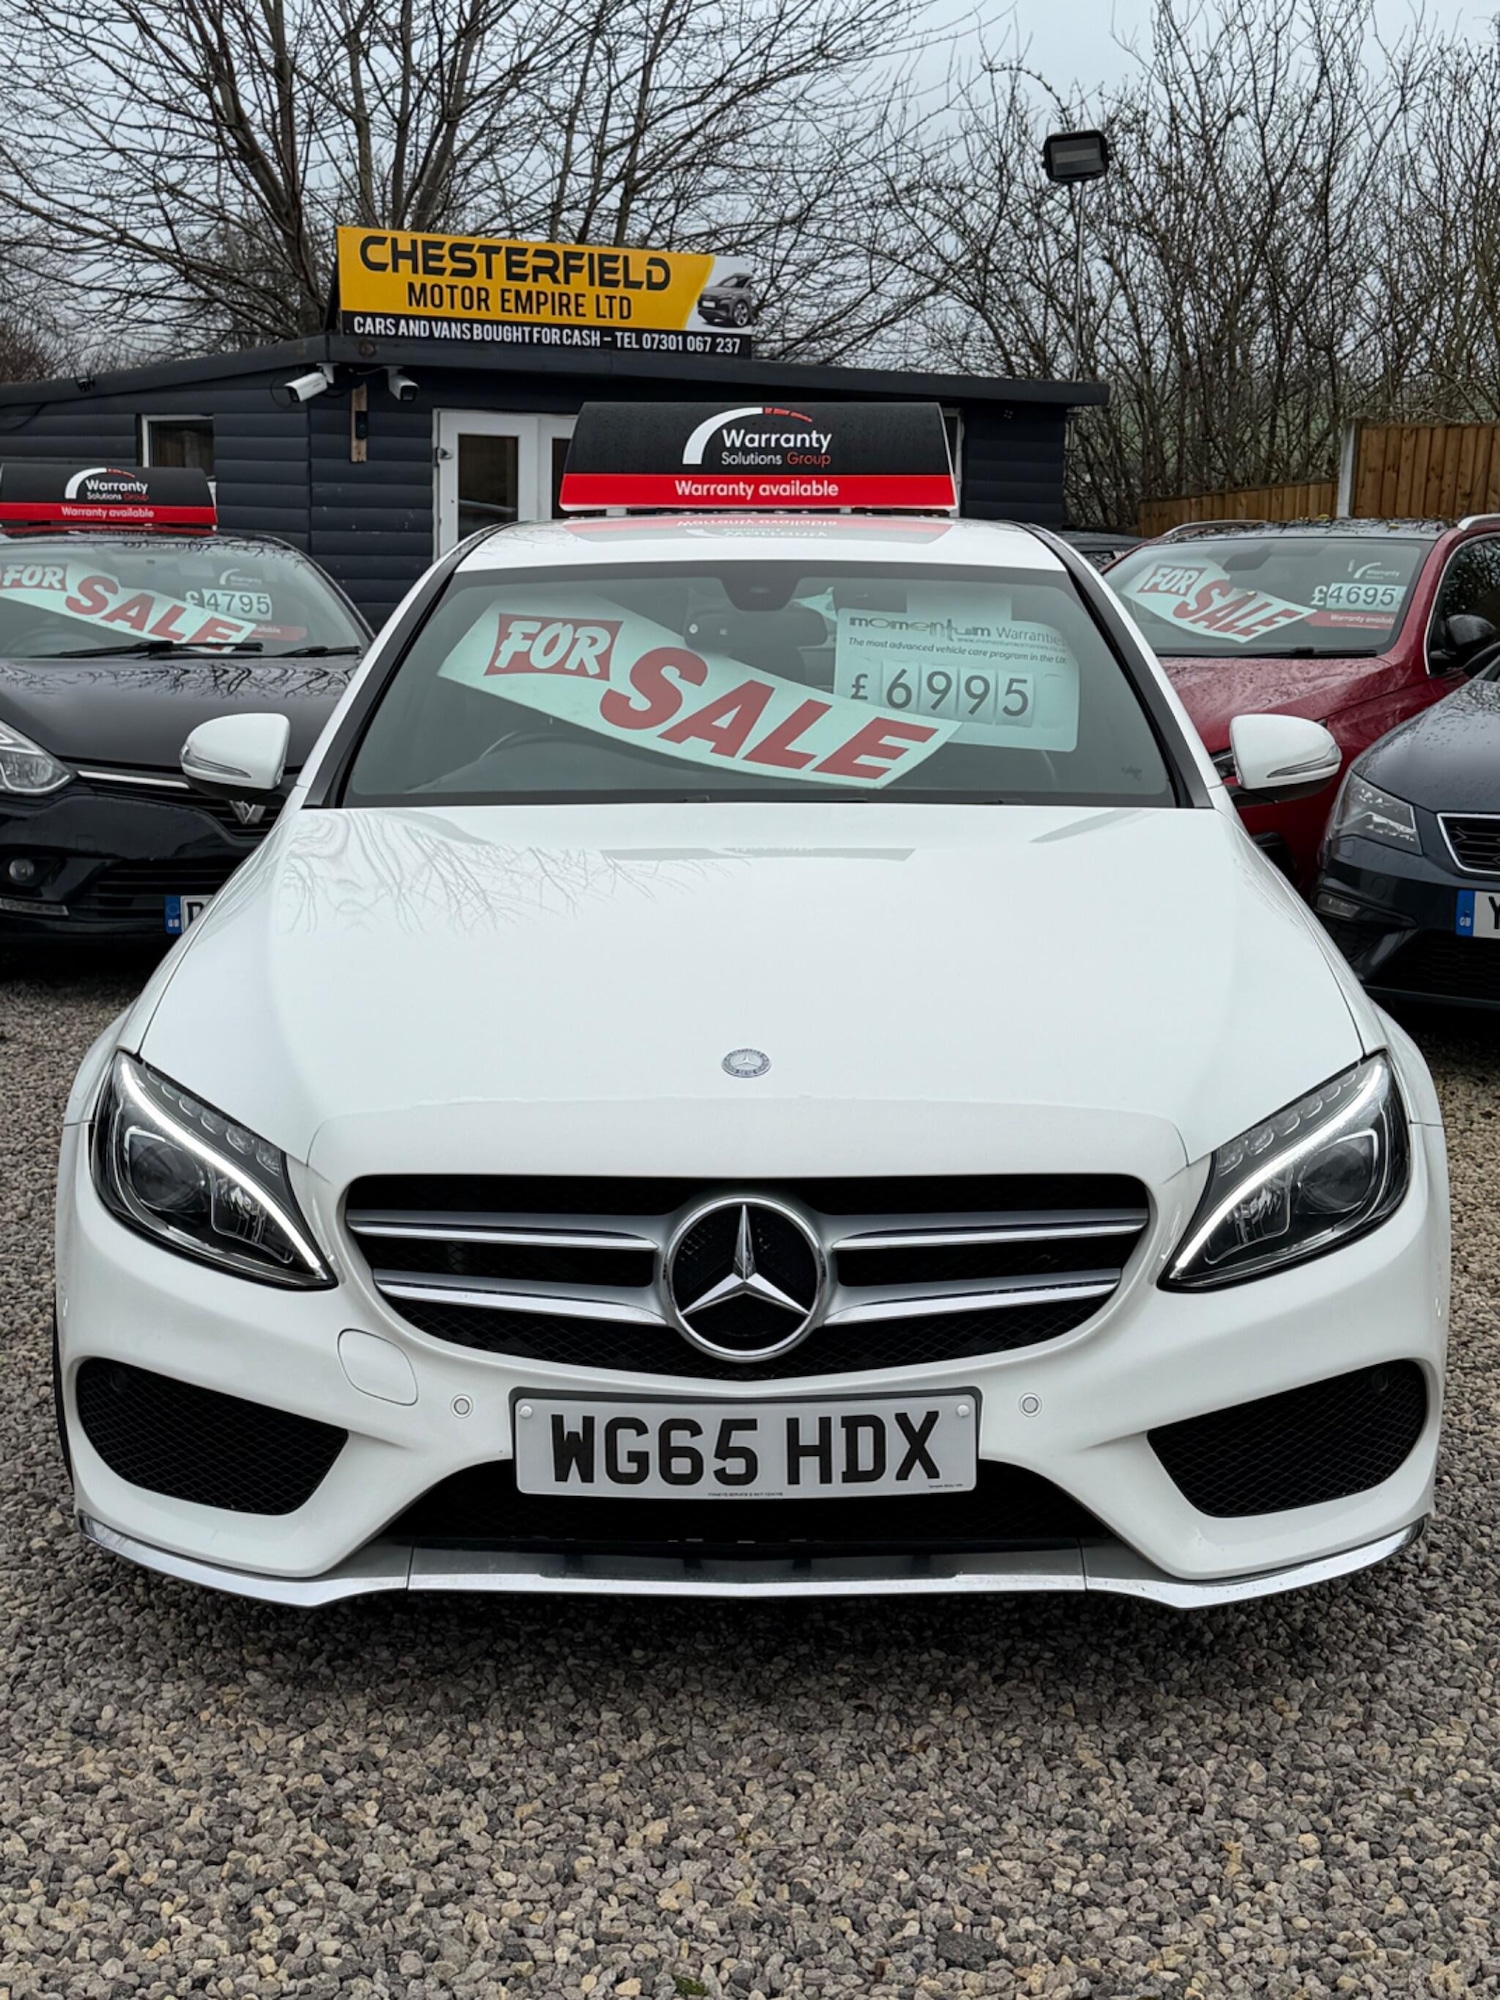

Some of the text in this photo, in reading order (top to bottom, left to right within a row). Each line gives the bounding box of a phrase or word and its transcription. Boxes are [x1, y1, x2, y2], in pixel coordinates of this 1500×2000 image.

[359, 235, 671, 290] CHESTERFIELD
[407, 281, 632, 320] MOTOR EMPIRE LTD
[353, 316, 396, 336] CARS
[397, 320, 430, 338] AND
[431, 321, 471, 340] VANS
[472, 324, 531, 344] BOUGHT
[533, 327, 561, 345] FOR
[562, 329, 600, 347] CASH
[615, 331, 640, 349] TEL
[642, 333, 683, 351] 07301
[686, 335, 712, 353] 067
[715, 338, 741, 354] 237
[721, 428, 832, 456] Warranty
[721, 451, 832, 468] Solutions Group
[85, 479, 148, 495] Warranty
[86, 491, 149, 502] Solutions Group
[675, 480, 839, 500] Warranty available
[61, 505, 155, 519] Warranty available
[2, 564, 245, 651] FOR SALE
[1143, 567, 1304, 637] FOR SALE
[849, 617, 991, 642] momentum
[849, 636, 865, 647] The
[866, 639, 889, 649] most
[889, 640, 935, 652] advanced
[935, 644, 967, 655] vehicle
[967, 647, 988, 657] care
[989, 650, 1029, 660] program
[1030, 651, 1039, 661] in
[1039, 654, 1054, 663] the
[497, 619, 939, 779] FOR SALE
[550, 1410, 941, 1487] WG65 HDX
